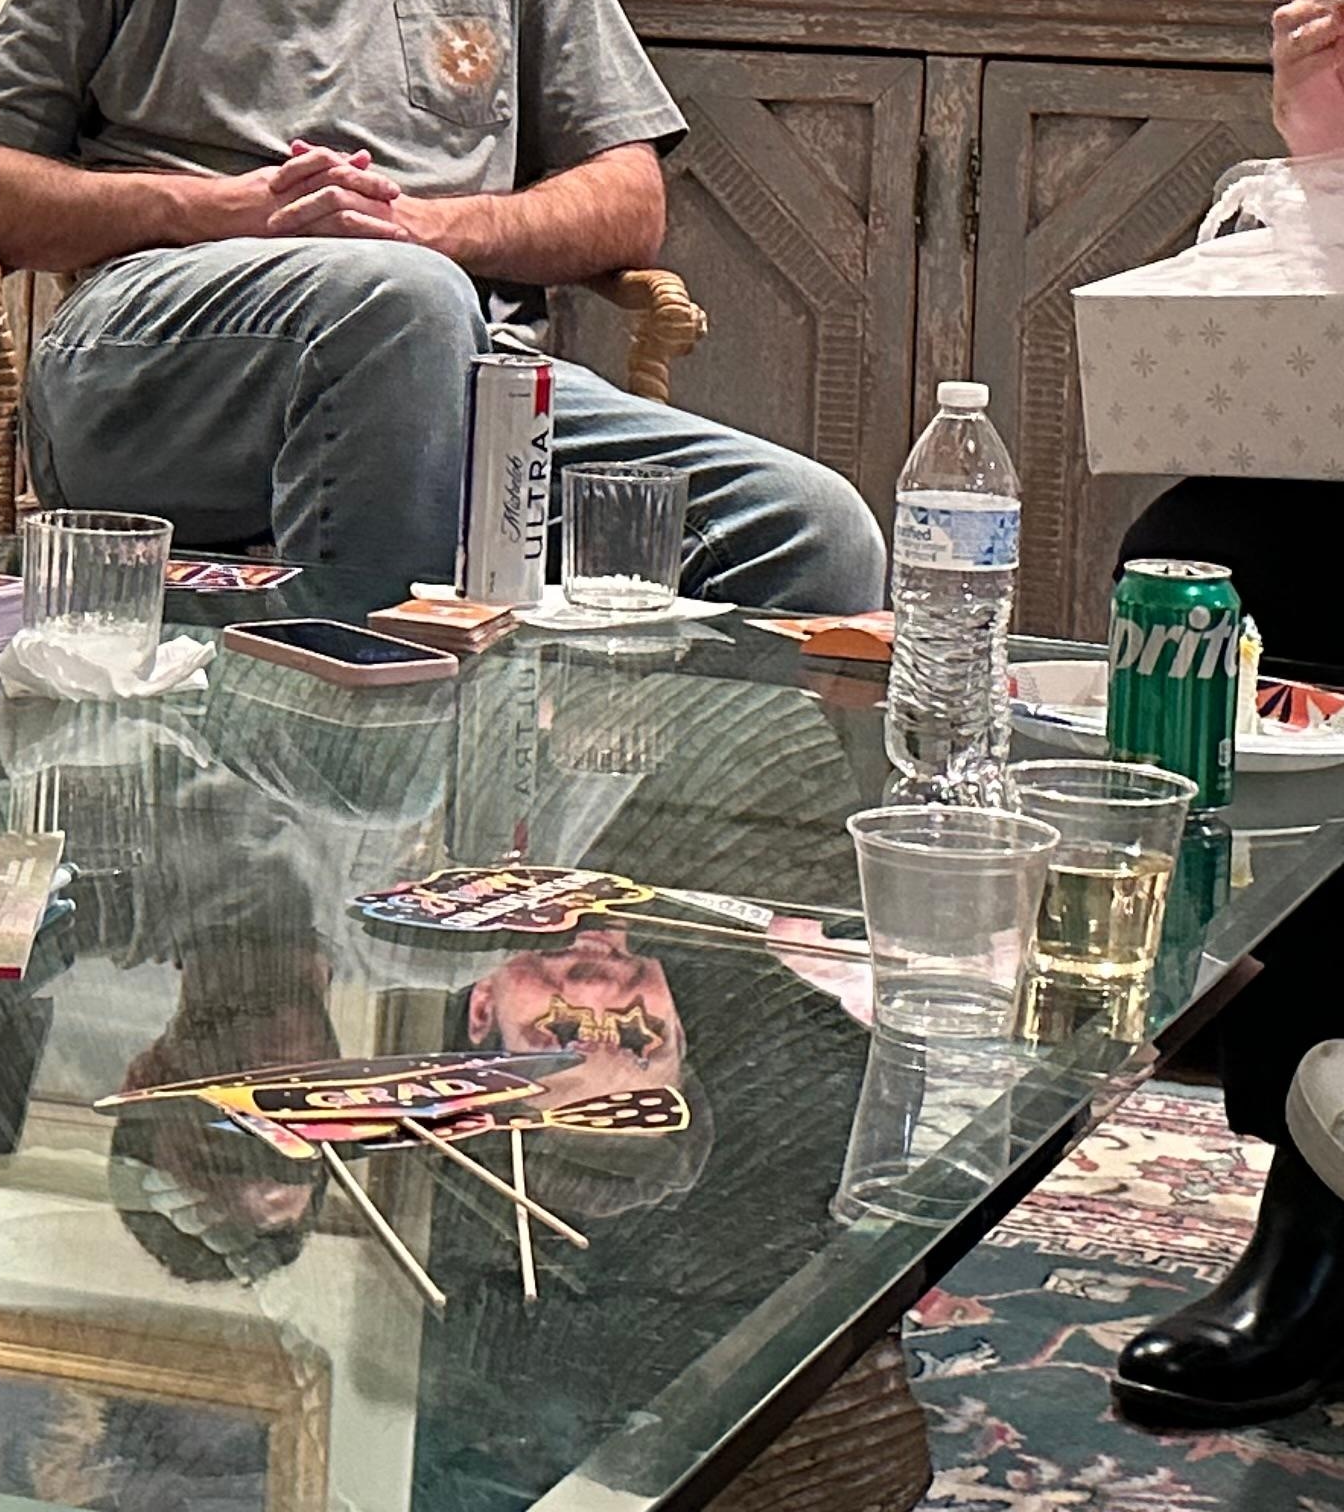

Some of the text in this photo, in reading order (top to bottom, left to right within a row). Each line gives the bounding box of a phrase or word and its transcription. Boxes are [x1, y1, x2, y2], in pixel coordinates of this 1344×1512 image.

[501, 454, 524, 544] Michelob
[524, 427, 550, 560] ULTRA
[305, 1078, 487, 1109] GRAD
